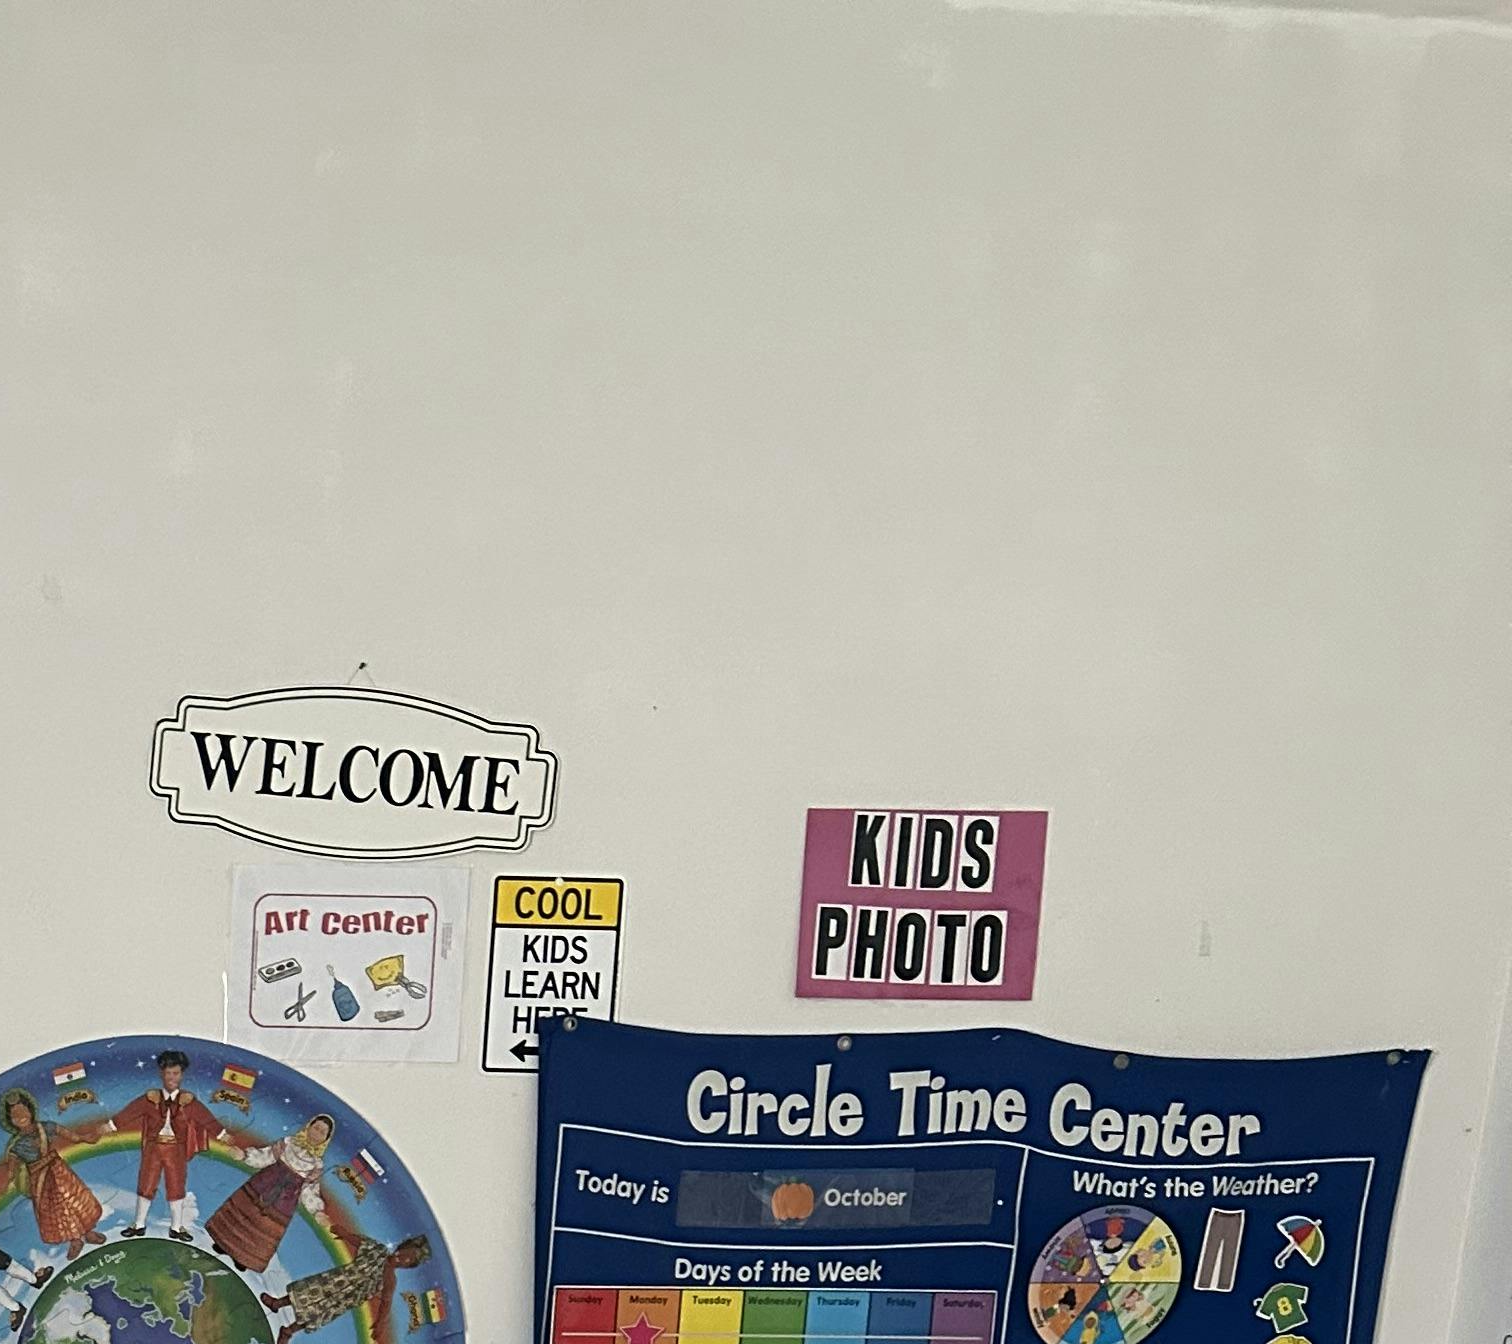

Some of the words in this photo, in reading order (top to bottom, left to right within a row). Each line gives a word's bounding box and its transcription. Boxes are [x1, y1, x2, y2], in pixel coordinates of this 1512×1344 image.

[190, 732, 521, 816] WELCOME
[851, 815, 995, 889] KIDS
[515, 886, 604, 921] COOL
[265, 909, 311, 936] Art
[522, 935, 589, 965] KIDS
[815, 906, 1003, 983] PHOTO
[504, 970, 602, 1000] LEARN
[688, 1063, 865, 1137] Circle
[890, 1070, 1028, 1137] Time
[1049, 1083, 1261, 1157] Center
[575, 1169, 646, 1203] Today
[651, 1178, 670, 1203] is
[824, 1188, 907, 1207] October
[1072, 1170, 1157, 1198] What's
[1164, 1177, 1205, 1198] the
[1211, 1173, 1320, 1197] Weather?
[675, 1258, 732, 1284] Days
[738, 1258, 764, 1282] of
[769, 1261, 810, 1283] the
[817, 1260, 883, 1283] Week
[568, 1295, 603, 1306] Sunday
[629, 1295, 669, 1306] Monday
[692, 1295, 733, 1306] Tuesday
[748, 1296, 803, 1307] Wednesday
[816, 1296, 861, 1307] Thursday
[886, 1298, 917, 1308] Friday
[1277, 1297, 1292, 1315] 8
